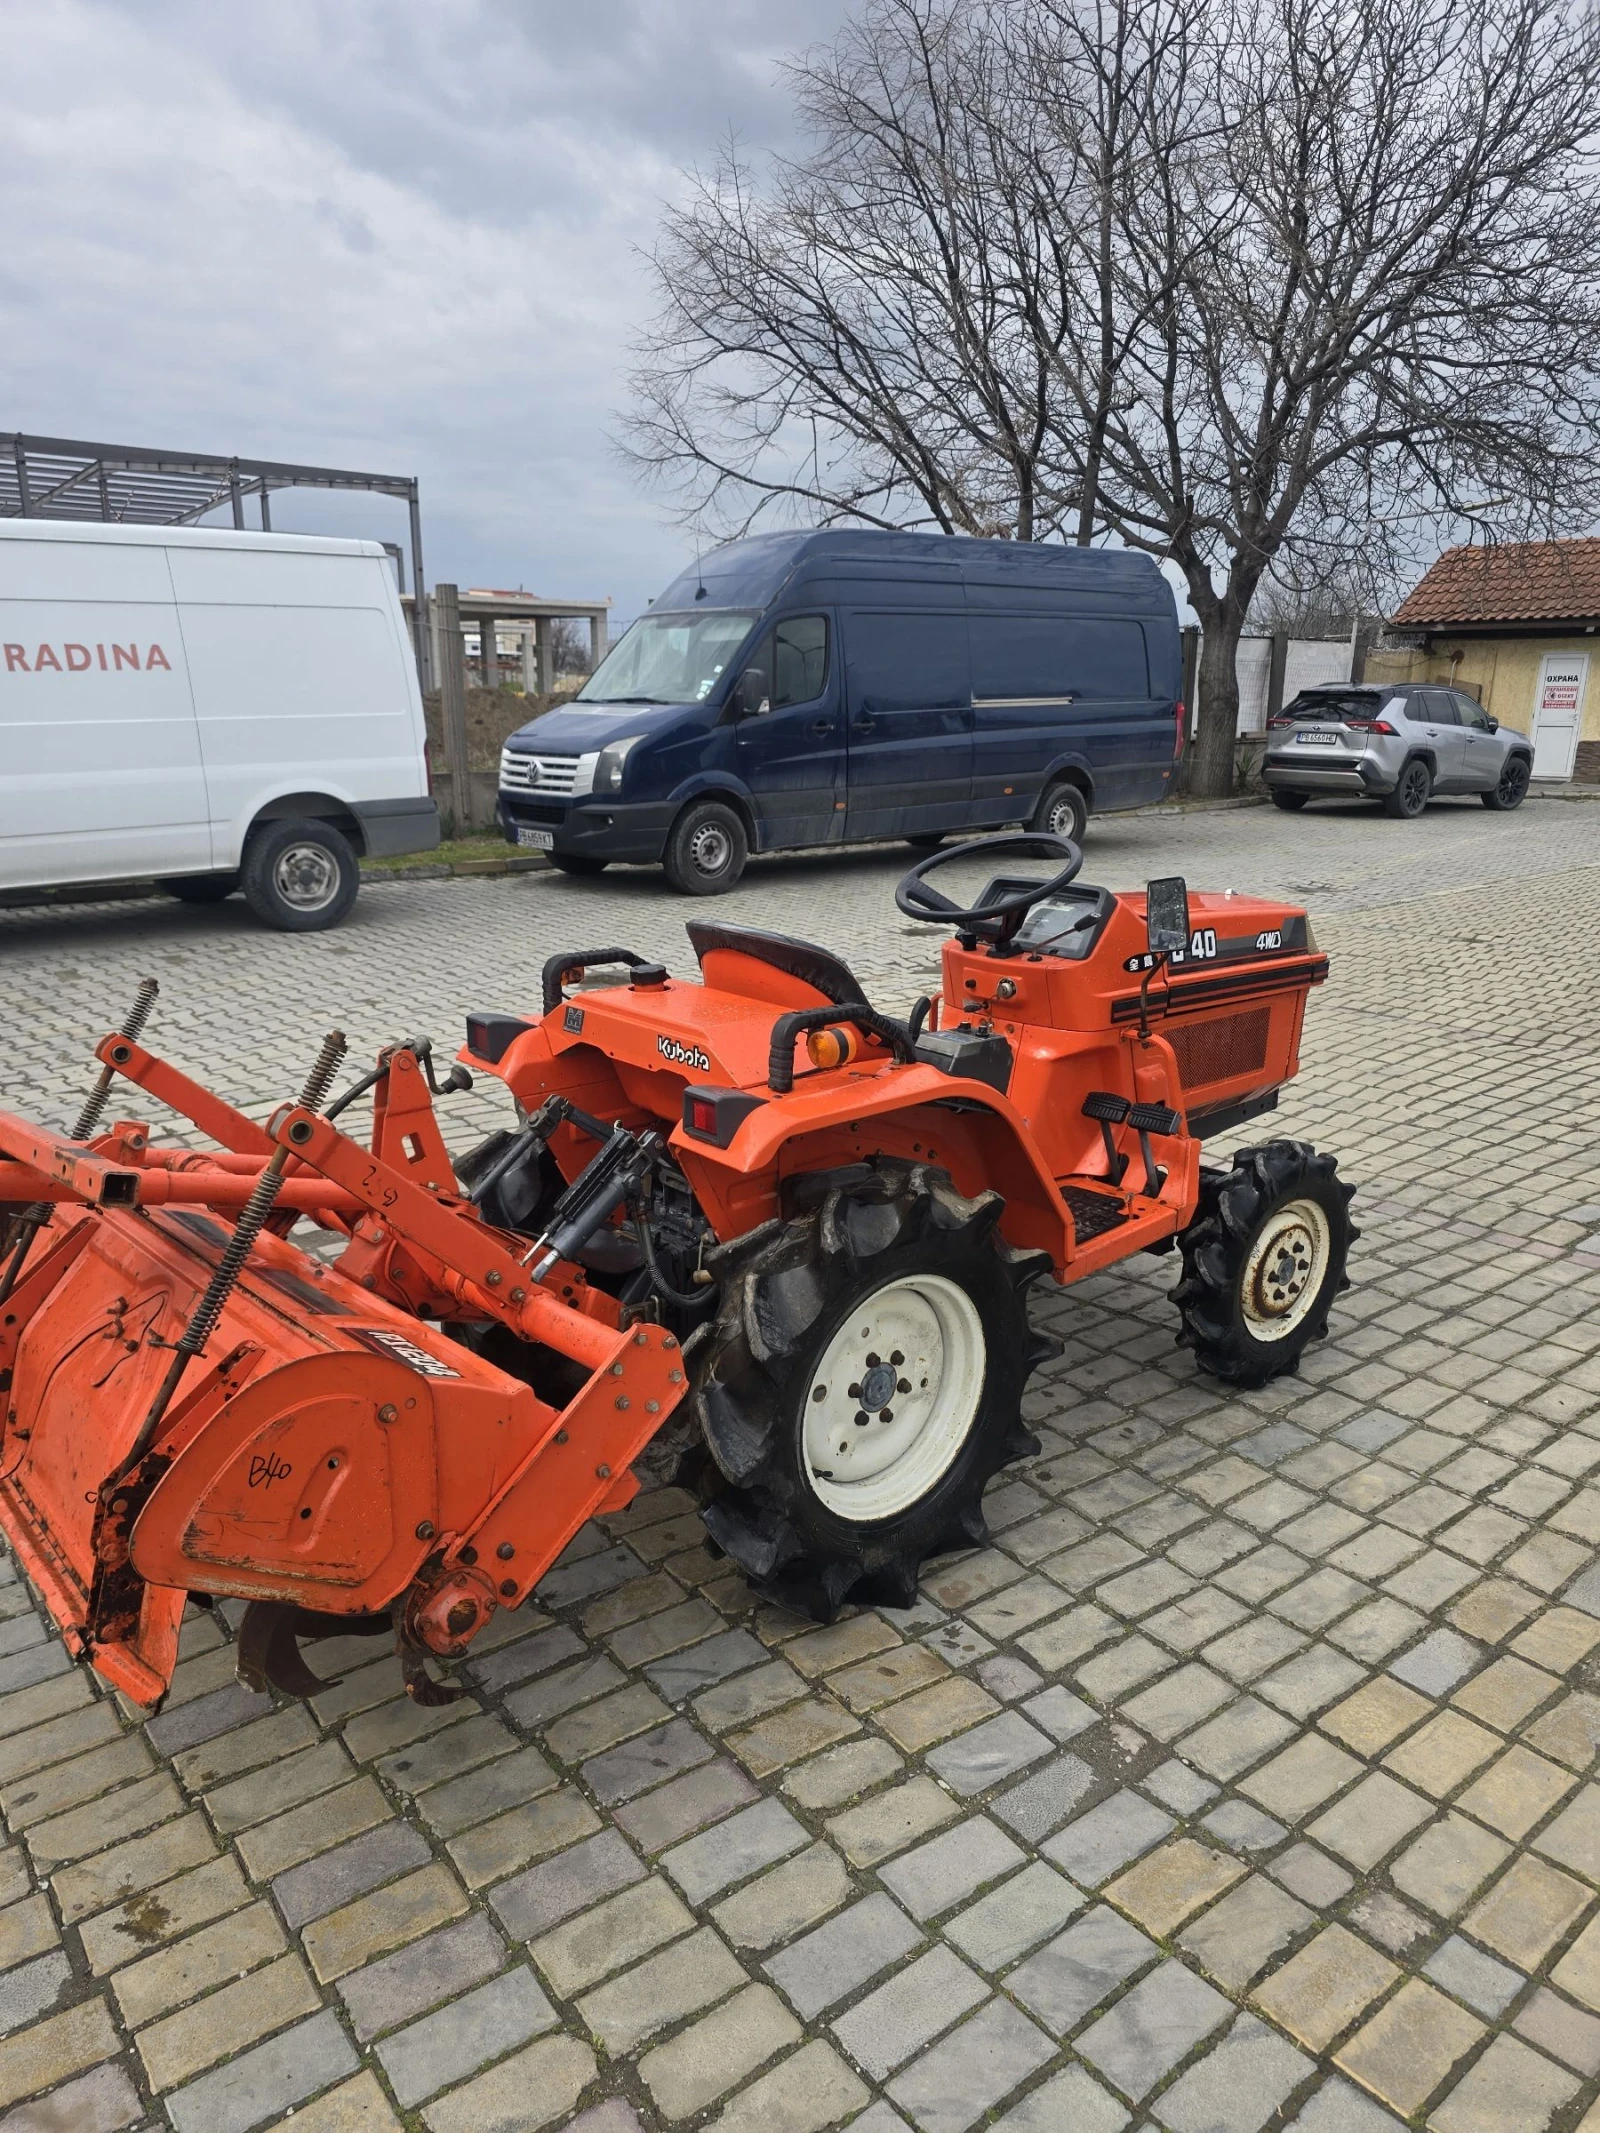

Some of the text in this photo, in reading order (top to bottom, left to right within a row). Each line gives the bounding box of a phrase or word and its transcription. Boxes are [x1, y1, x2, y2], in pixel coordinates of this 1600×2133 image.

[3, 643, 172, 672] RADINA
[1256, 931, 1282, 950] 4WD
[658, 1035, 710, 1071] Kubota
[248, 1451, 292, 1490] B40
